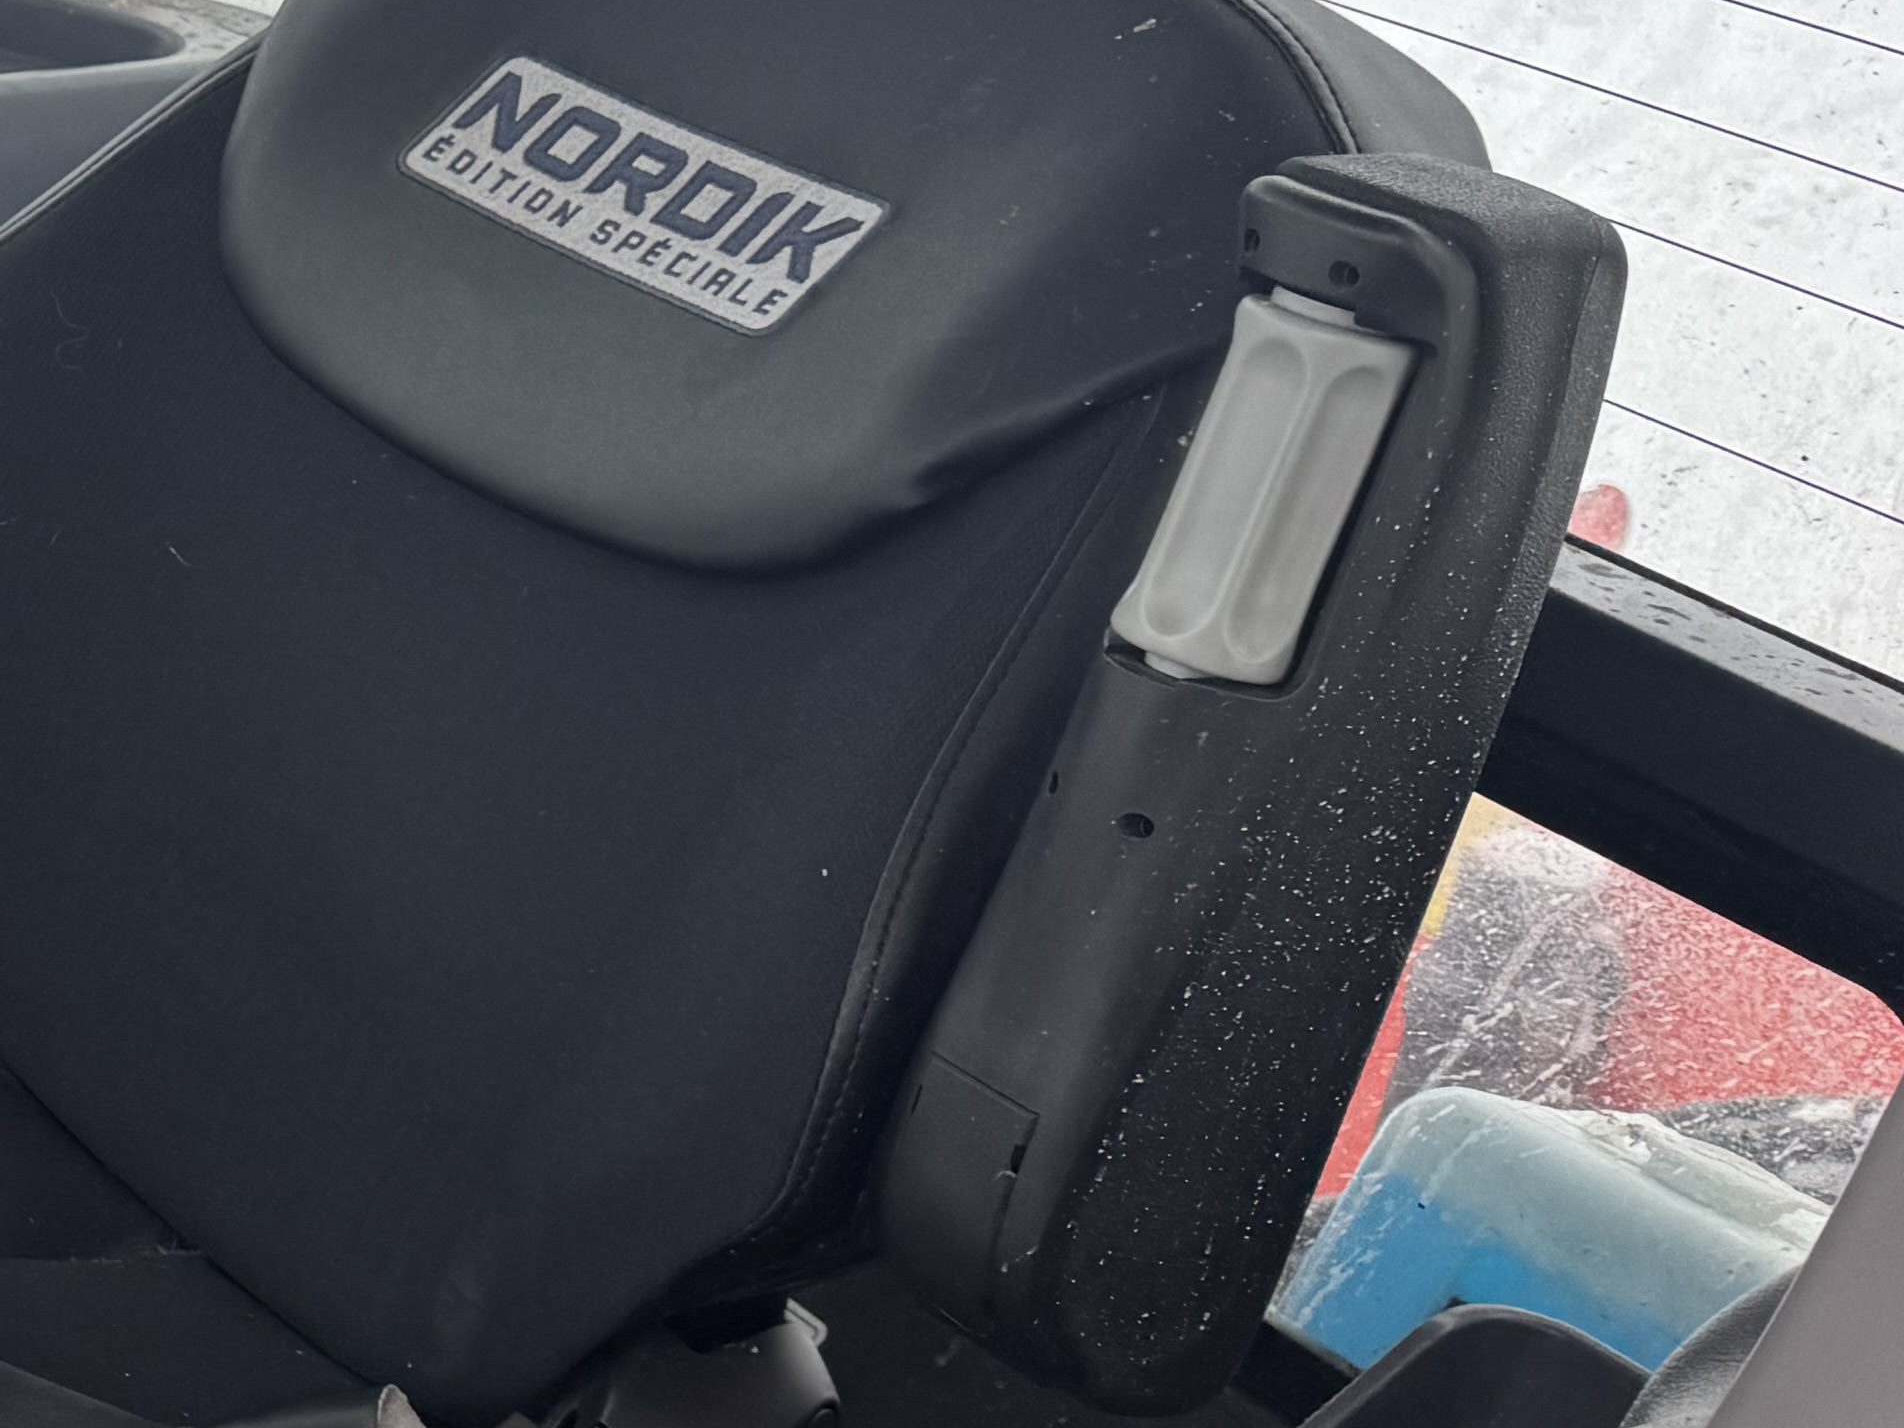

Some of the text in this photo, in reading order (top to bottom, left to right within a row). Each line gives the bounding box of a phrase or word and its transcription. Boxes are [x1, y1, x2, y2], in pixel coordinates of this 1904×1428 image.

[421, 134, 788, 315] ÉDITION SPÉCIALE
[454, 71, 865, 283] NORDIK
